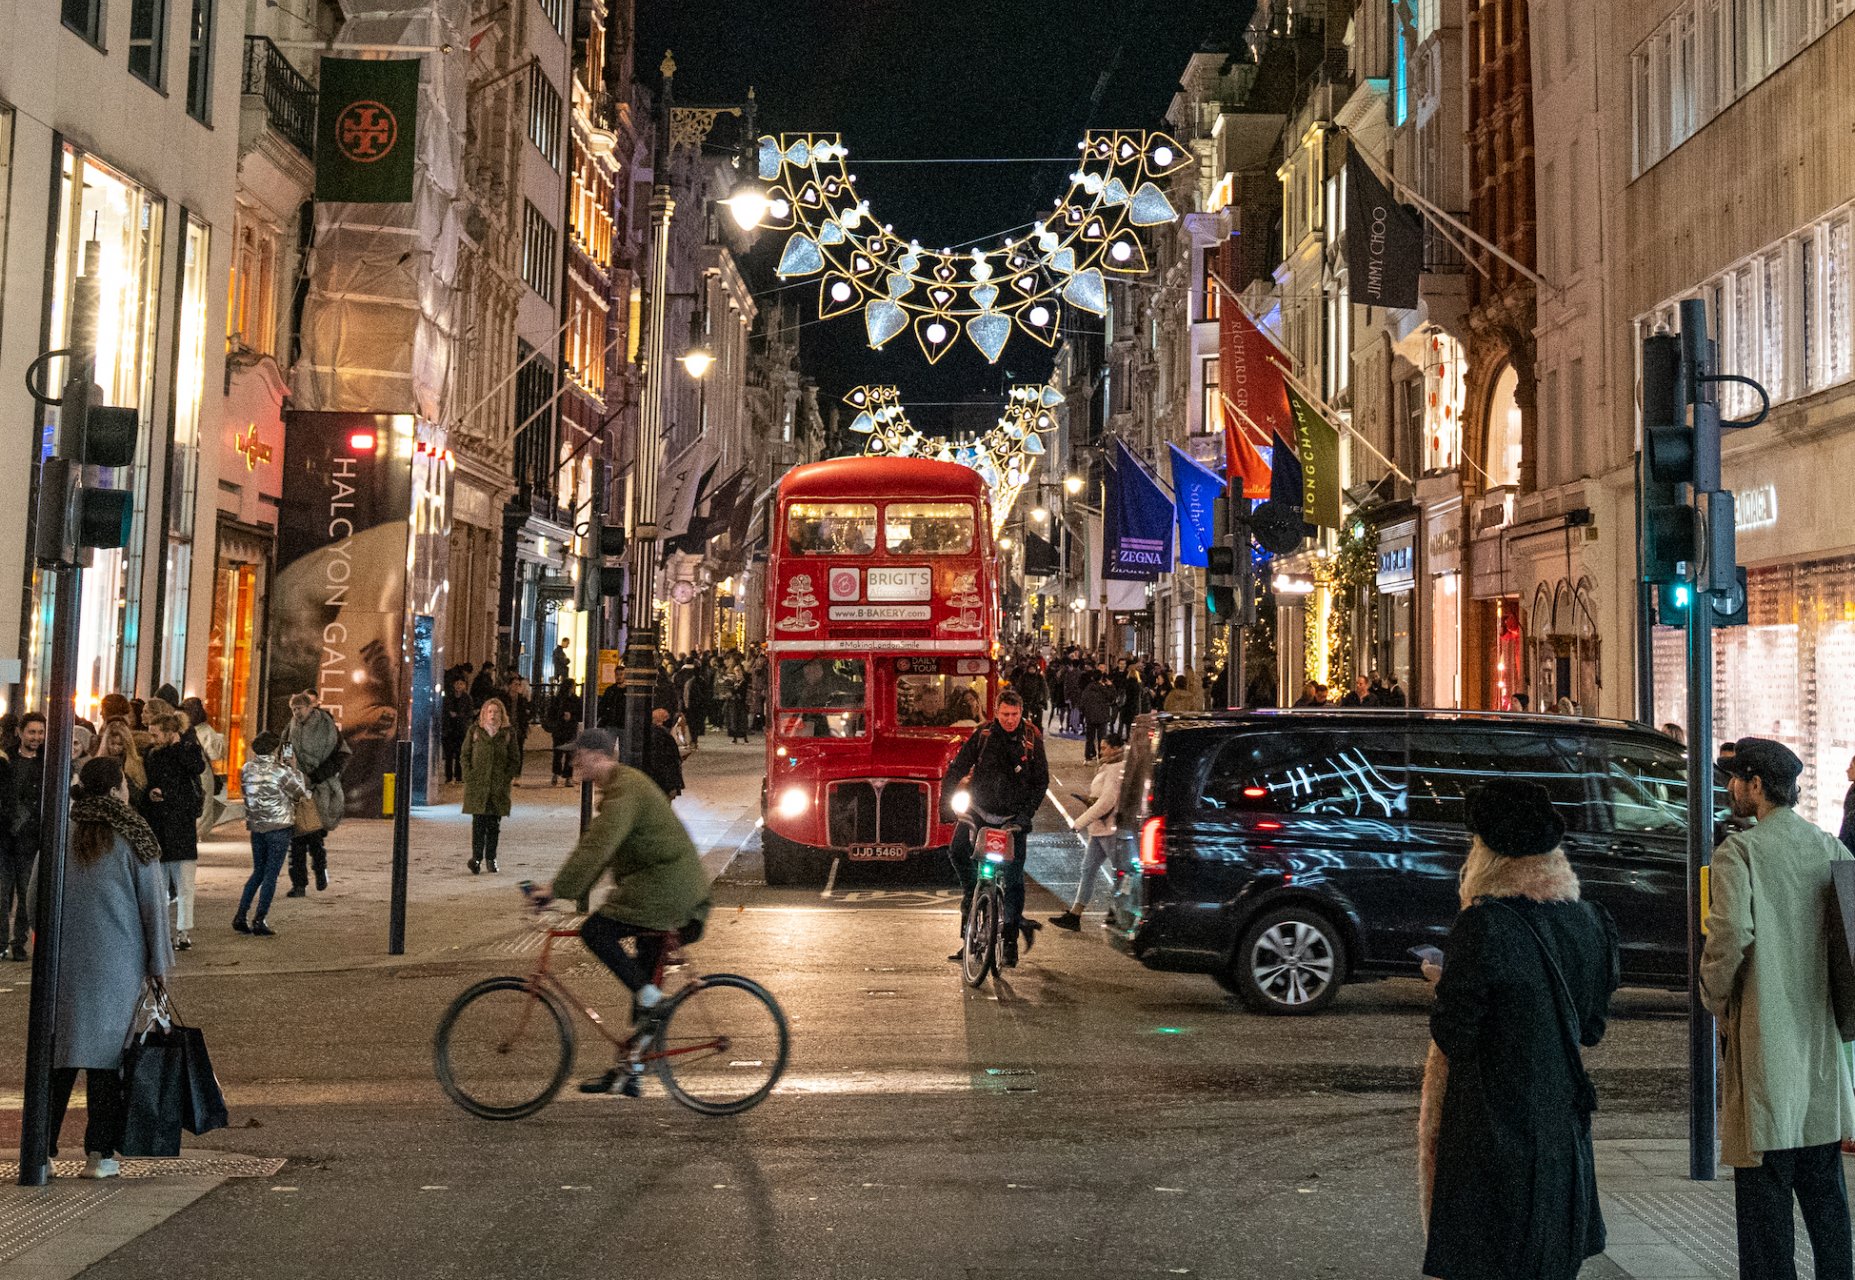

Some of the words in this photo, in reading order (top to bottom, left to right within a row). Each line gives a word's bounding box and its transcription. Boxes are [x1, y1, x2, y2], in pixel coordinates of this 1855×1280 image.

[1369, 206, 1387, 255] CHOO
[1367, 258, 1383, 299] JIMMY
[1231, 320, 1246, 385] RICHARD
[1292, 399, 1315, 515] LONGCHAMP
[325, 457, 357, 606] HALCYON
[1120, 551, 1163, 565] ZEGNA
[914, 587, 929, 597] Tea
[839, 641, 920, 650] #MakingLondonSmile
[912, 657, 937, 665] DAILY
[912, 665, 937, 673] TOUR
[319, 622, 348, 732] GALLE
[853, 847, 873, 857] JJD
[876, 847, 903, 857] 546D
